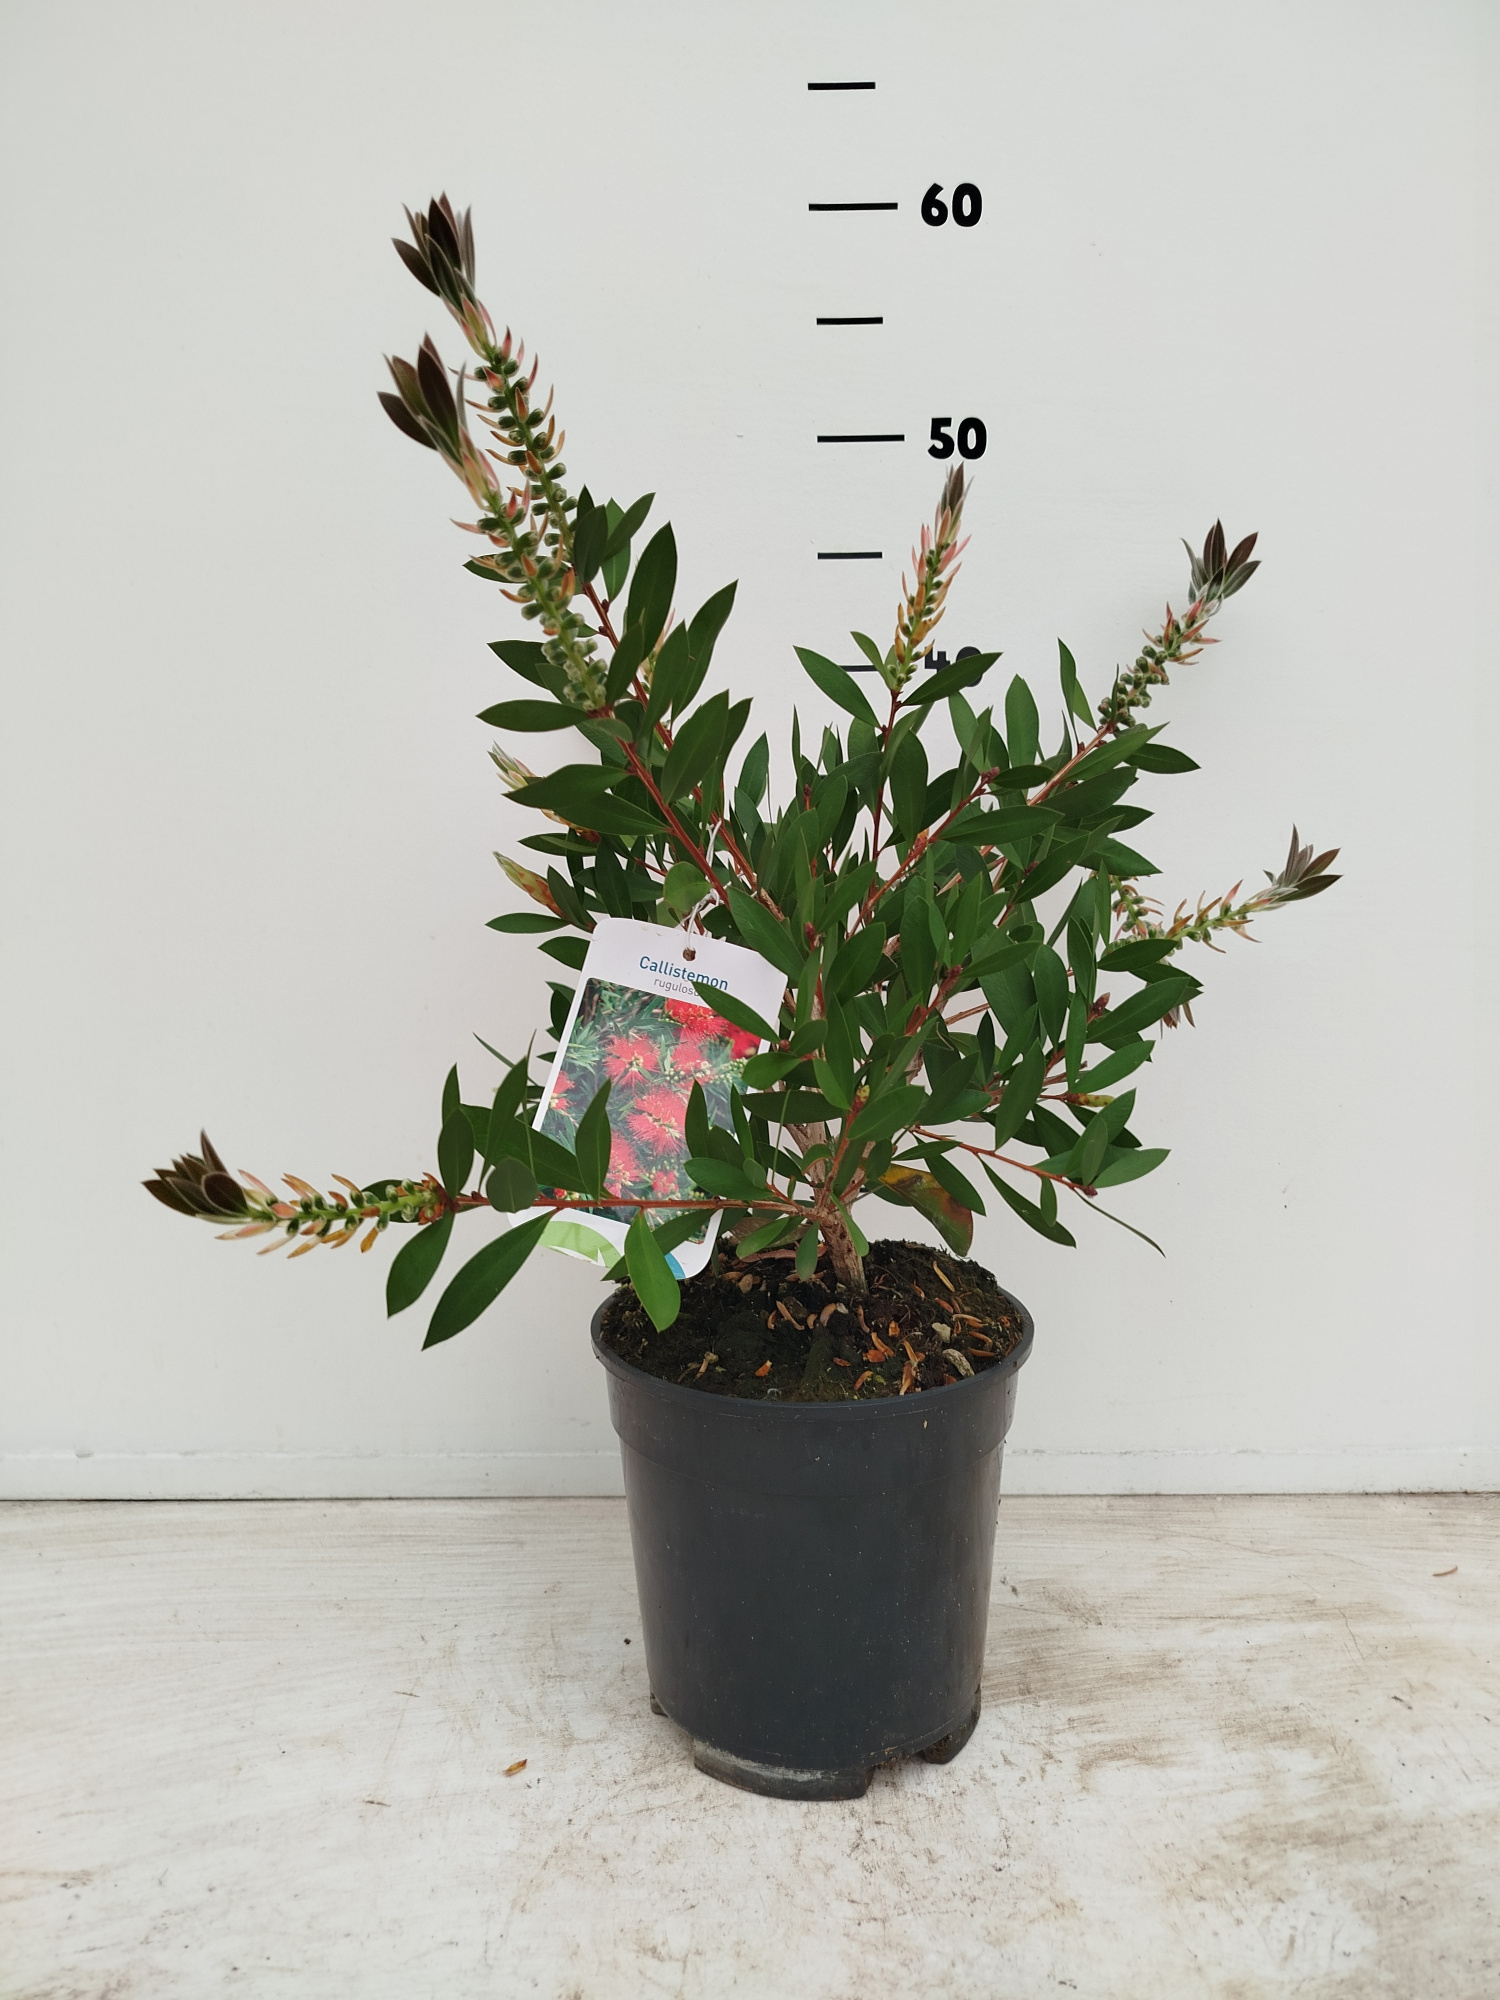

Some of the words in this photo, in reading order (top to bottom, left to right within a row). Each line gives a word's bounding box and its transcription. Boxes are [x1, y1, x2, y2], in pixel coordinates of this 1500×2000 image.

[920, 182, 983, 228] 60
[927, 416, 987, 461] 50
[638, 955, 729, 991] Callistemon
